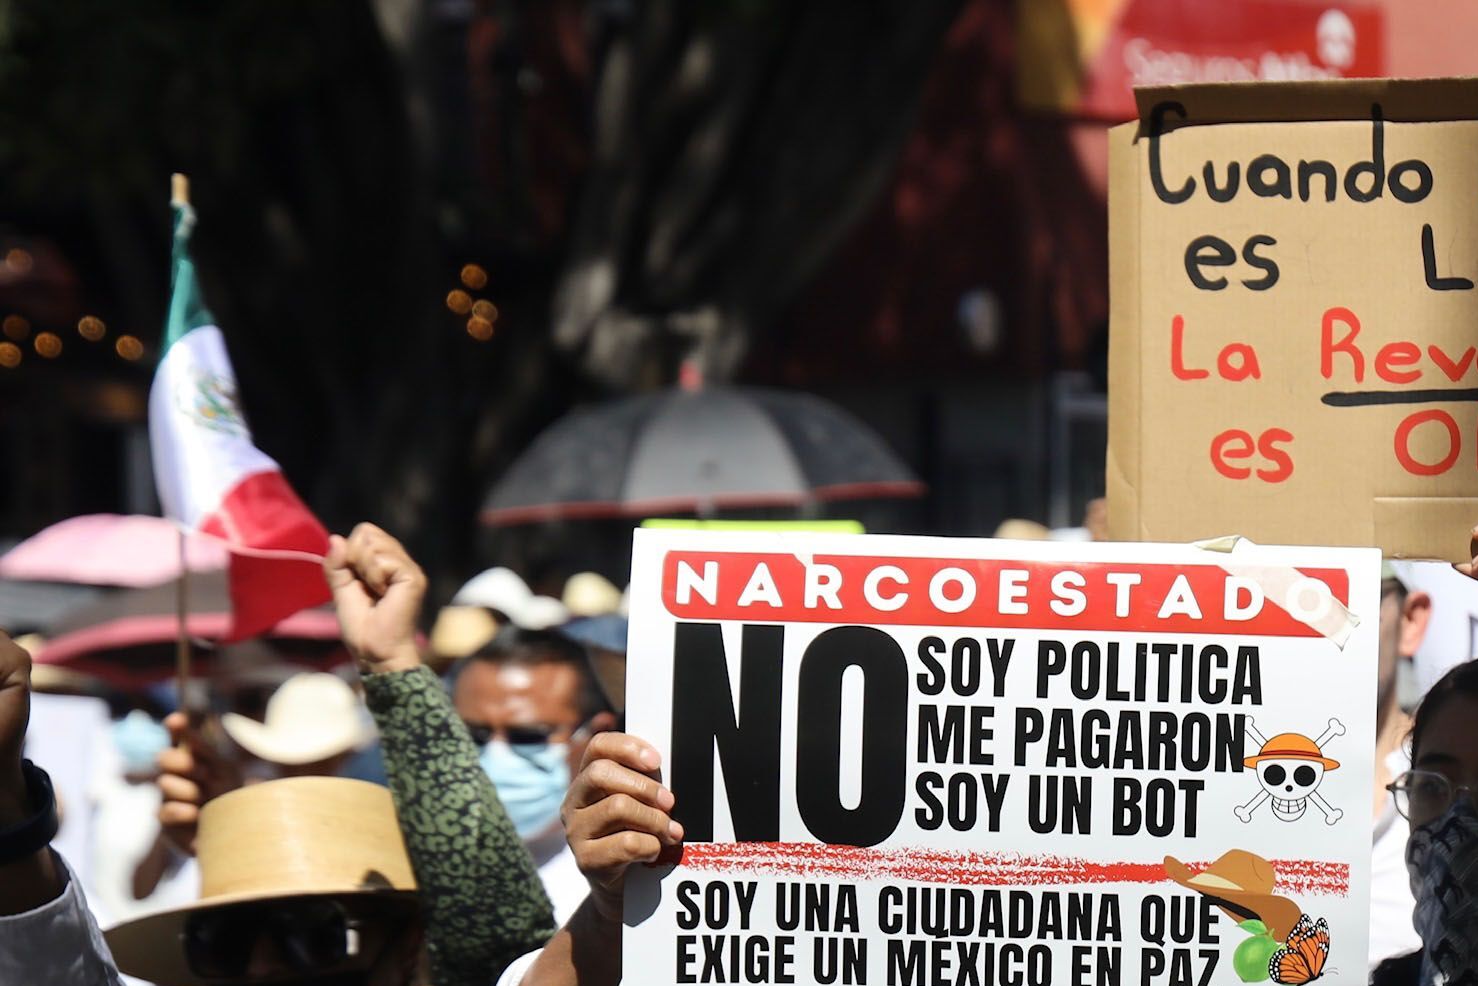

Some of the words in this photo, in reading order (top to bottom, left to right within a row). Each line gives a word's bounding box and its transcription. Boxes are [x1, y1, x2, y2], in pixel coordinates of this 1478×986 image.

[1147, 101, 1434, 204] Cuando
[1184, 235, 1280, 291] es
[1171, 315, 1261, 382] La
[1210, 427, 1294, 483] es
[675, 560, 1331, 622] NARCOESTADO
[916, 635, 1015, 699] SOY
[1036, 639, 1263, 706] POLITICA
[670, 621, 909, 848] NO
[916, 704, 995, 767] ME
[1015, 707, 1246, 773] PAGARON
[914, 771, 1011, 834] SOY
[1028, 775, 1092, 836] UN
[1112, 778, 1206, 838] BOT
[675, 880, 758, 930] SOY
[775, 882, 860, 933] UNA
[878, 885, 1122, 942] CIUDADANA
[1140, 894, 1221, 945] QUE
[675, 935, 795, 985] EXIGE
[813, 936, 868, 986] UN
